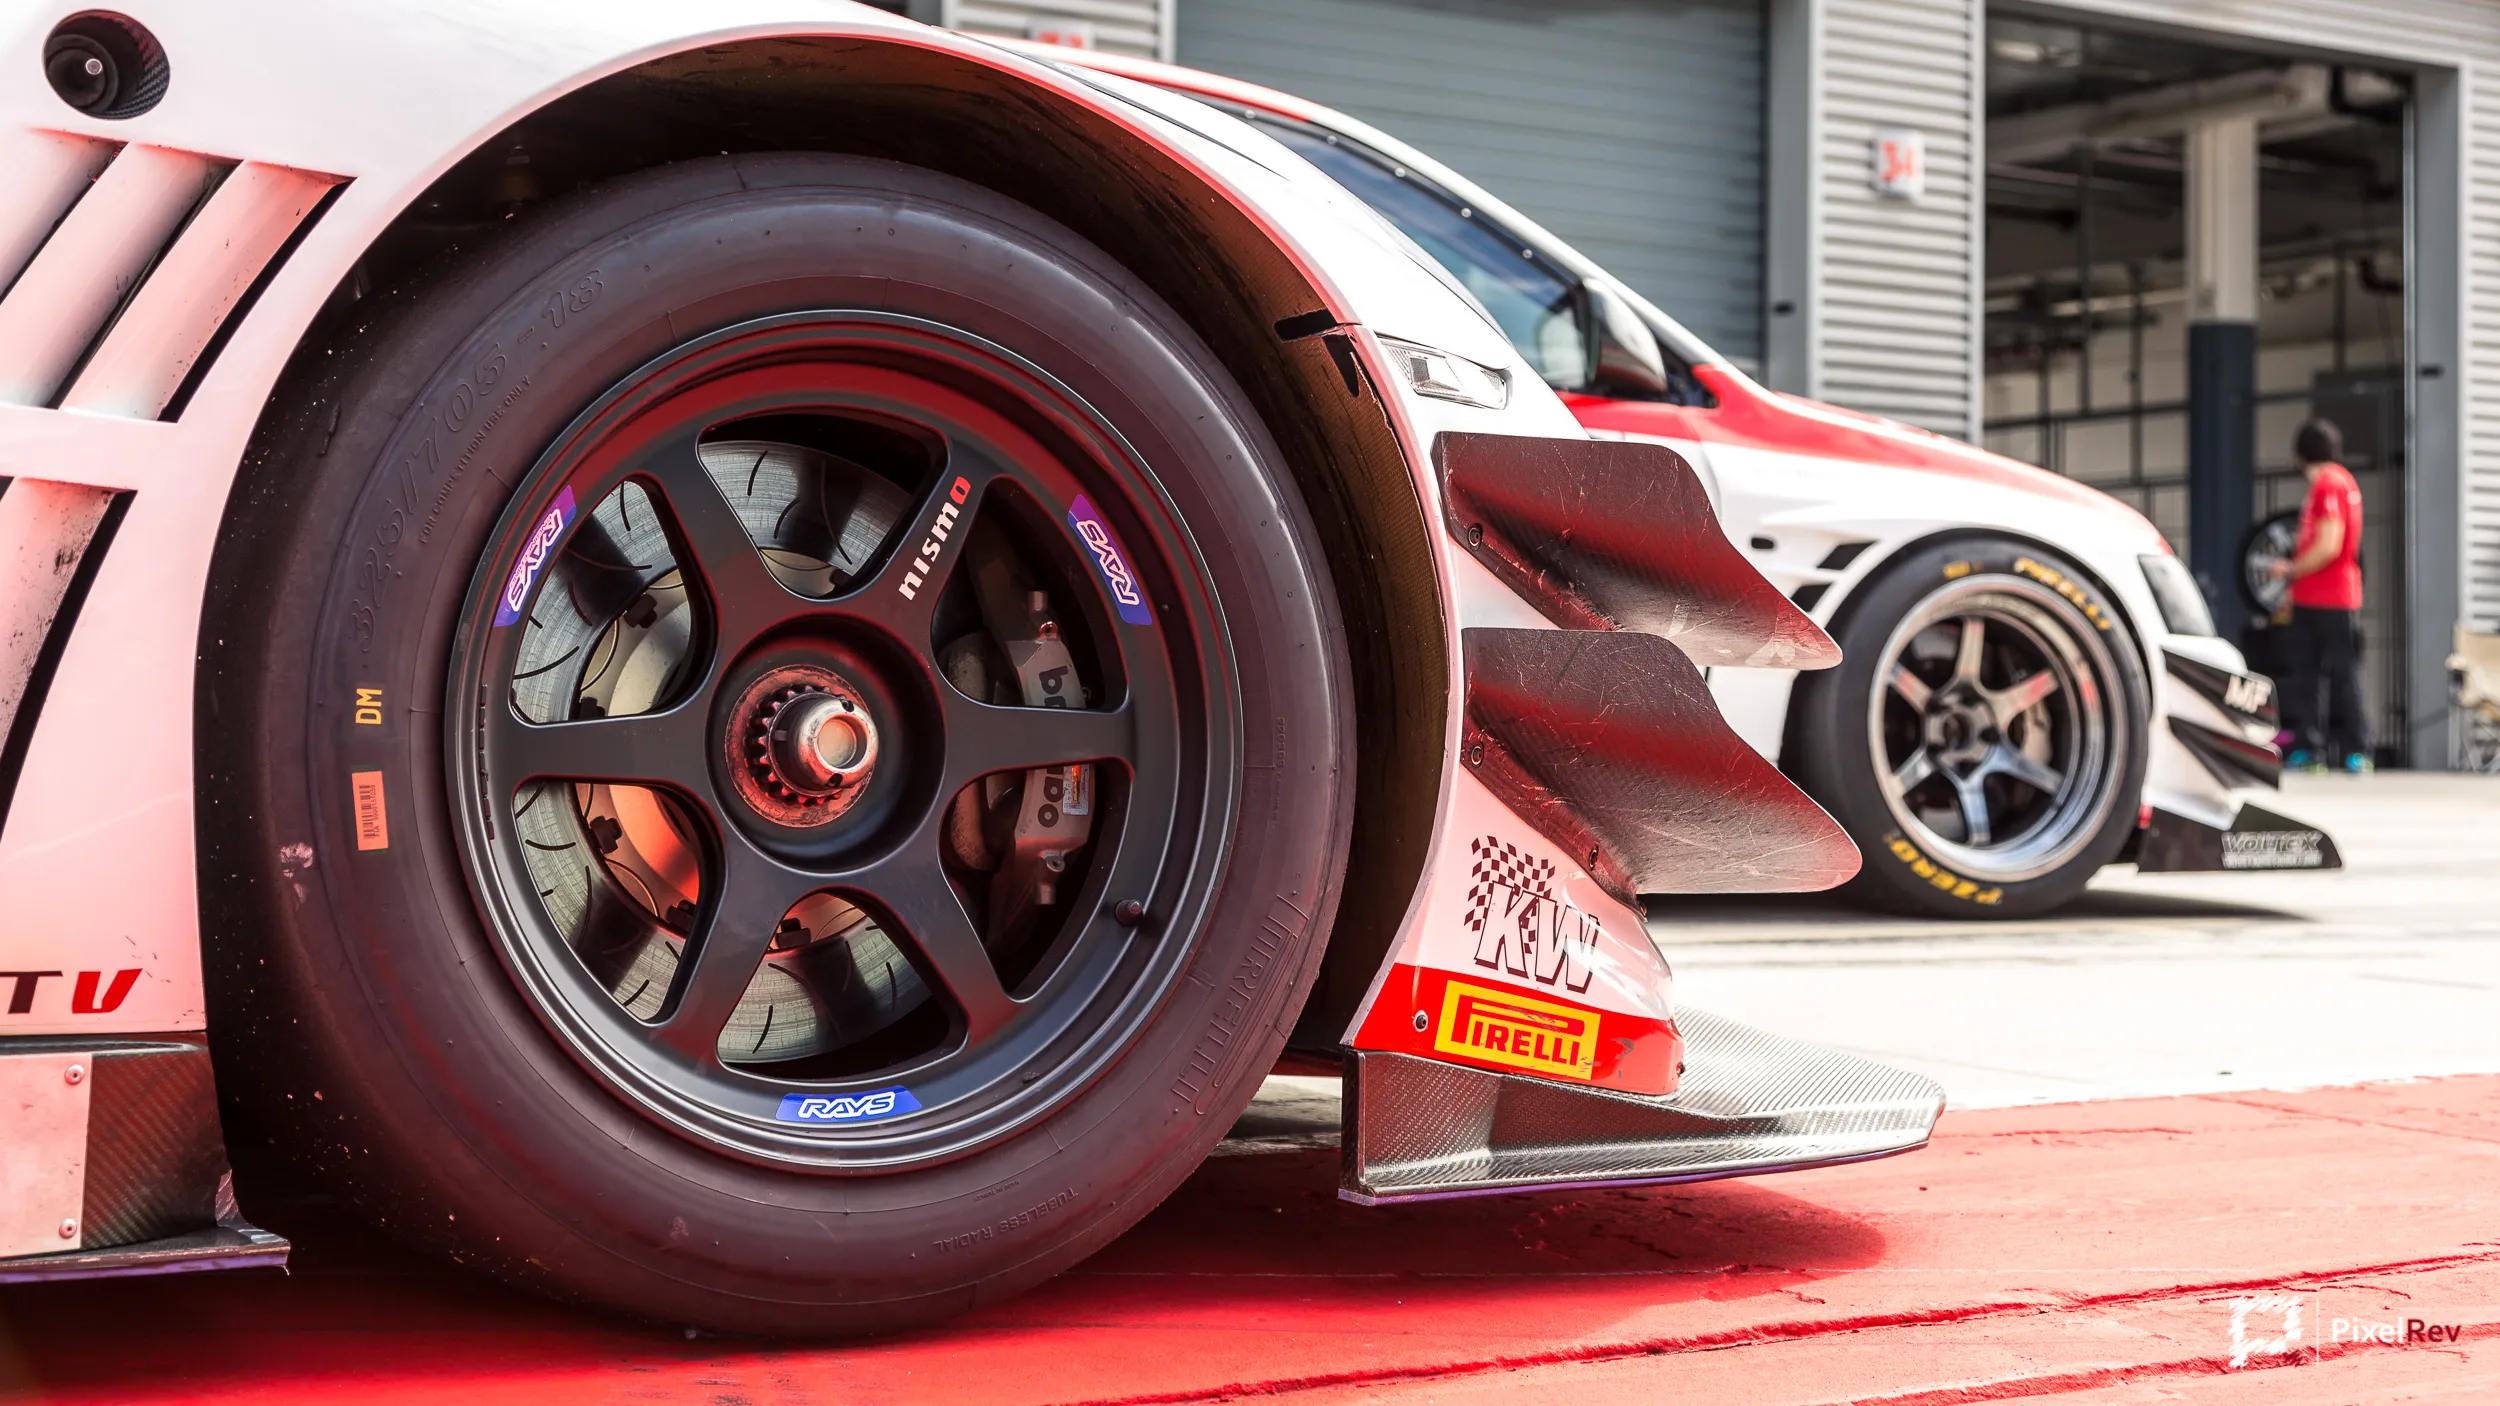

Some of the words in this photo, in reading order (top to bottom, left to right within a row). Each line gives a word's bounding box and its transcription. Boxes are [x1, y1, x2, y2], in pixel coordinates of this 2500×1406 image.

[418, 516, 437, 545] FOR
[432, 430, 487, 515] COMPETITION
[483, 405, 505, 432] USE
[504, 375, 533, 408] ONLY
[508, 509, 563, 612] RAYS
[1076, 520, 1139, 605] RAYS
[355, 688, 383, 725] DM
[1474, 880, 1601, 994] KW
[1451, 993, 1585, 1067] PIRELLI
[798, 1091, 896, 1119] RAYS
[933, 1226, 993, 1253] RADIAL
[1000, 1187, 1079, 1233] TUBELESS
